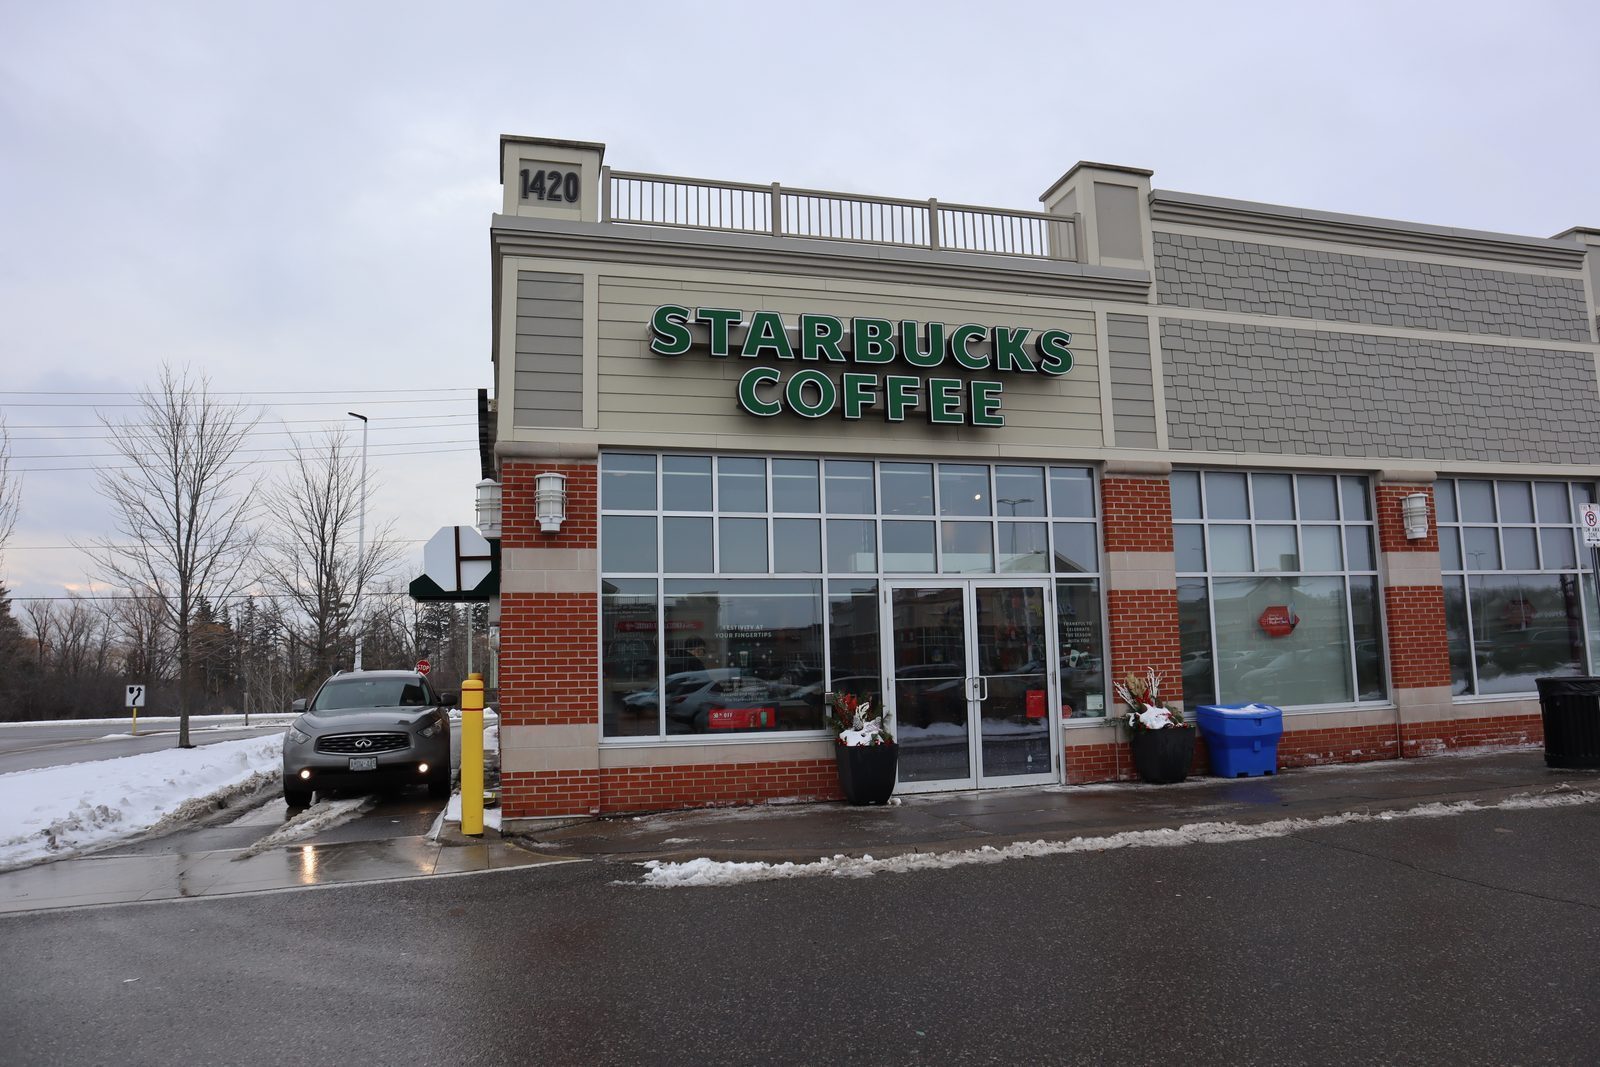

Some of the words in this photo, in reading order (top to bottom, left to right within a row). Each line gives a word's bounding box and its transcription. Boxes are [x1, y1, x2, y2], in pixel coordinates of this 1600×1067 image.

[520, 169, 579, 203] 1420
[650, 304, 1075, 376] STARBUCKS
[737, 366, 1006, 428] COFFEE
[734, 631, 772, 639] FINGERTIPS
